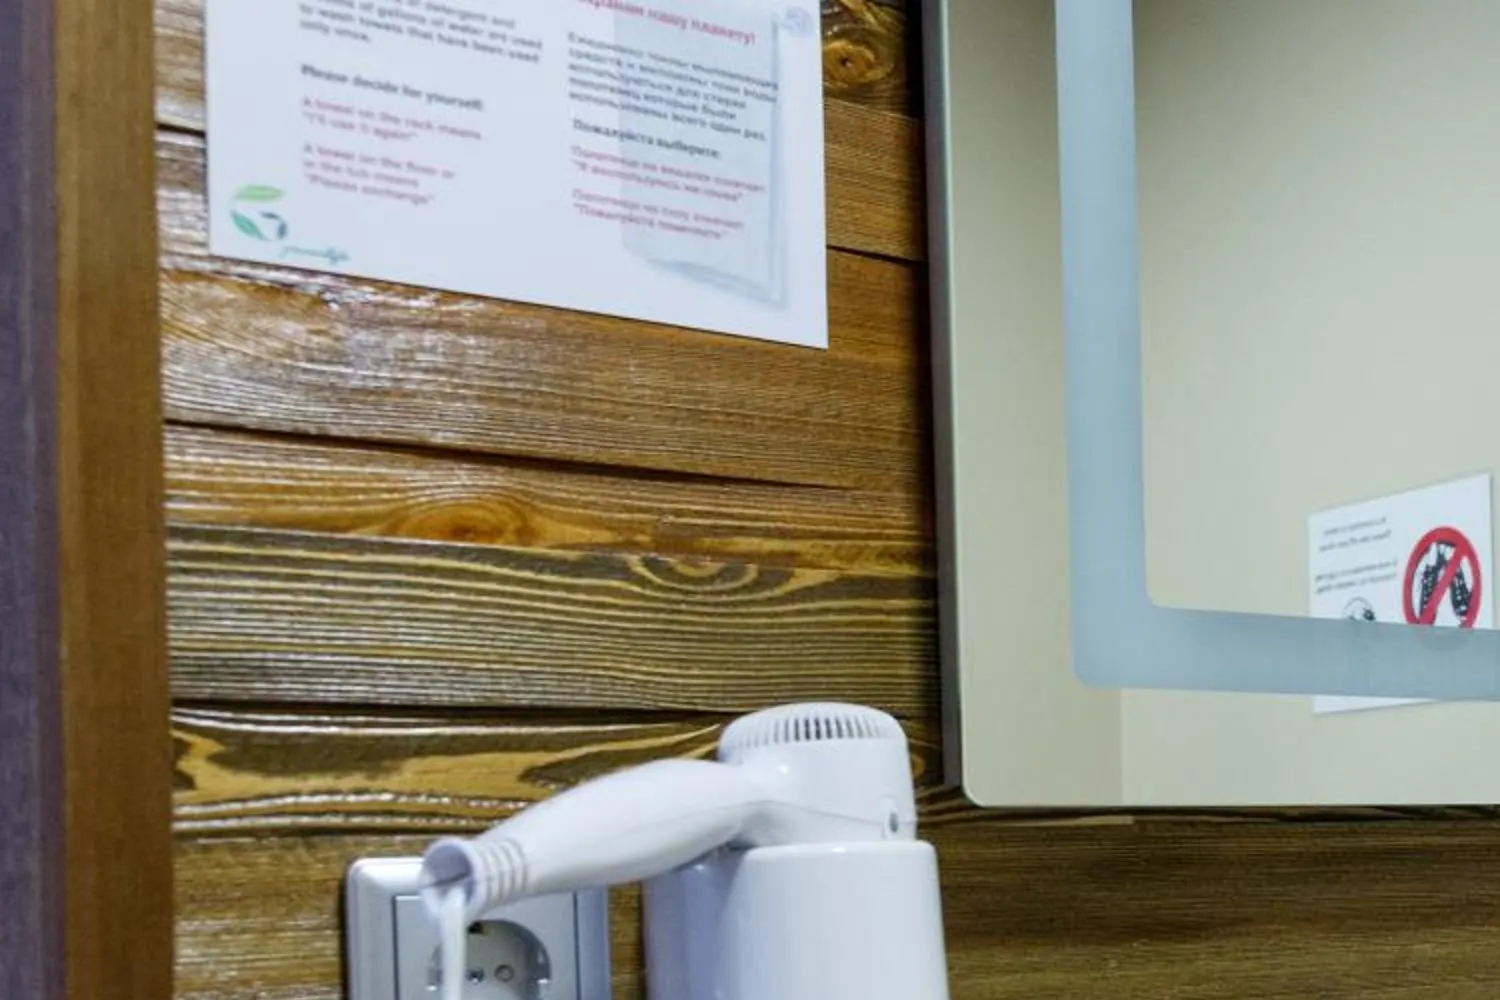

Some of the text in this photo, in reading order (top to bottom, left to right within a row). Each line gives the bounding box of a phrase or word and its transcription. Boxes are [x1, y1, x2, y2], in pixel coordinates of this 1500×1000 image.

[359, 16, 404, 33] towels
[437, 33, 468, 47] have
[511, 36, 542, 49] used
[691, 19, 755, 45] планету!
[300, 63, 348, 83] Please
[352, 75, 398, 94] decide
[402, 85, 421, 98] for
